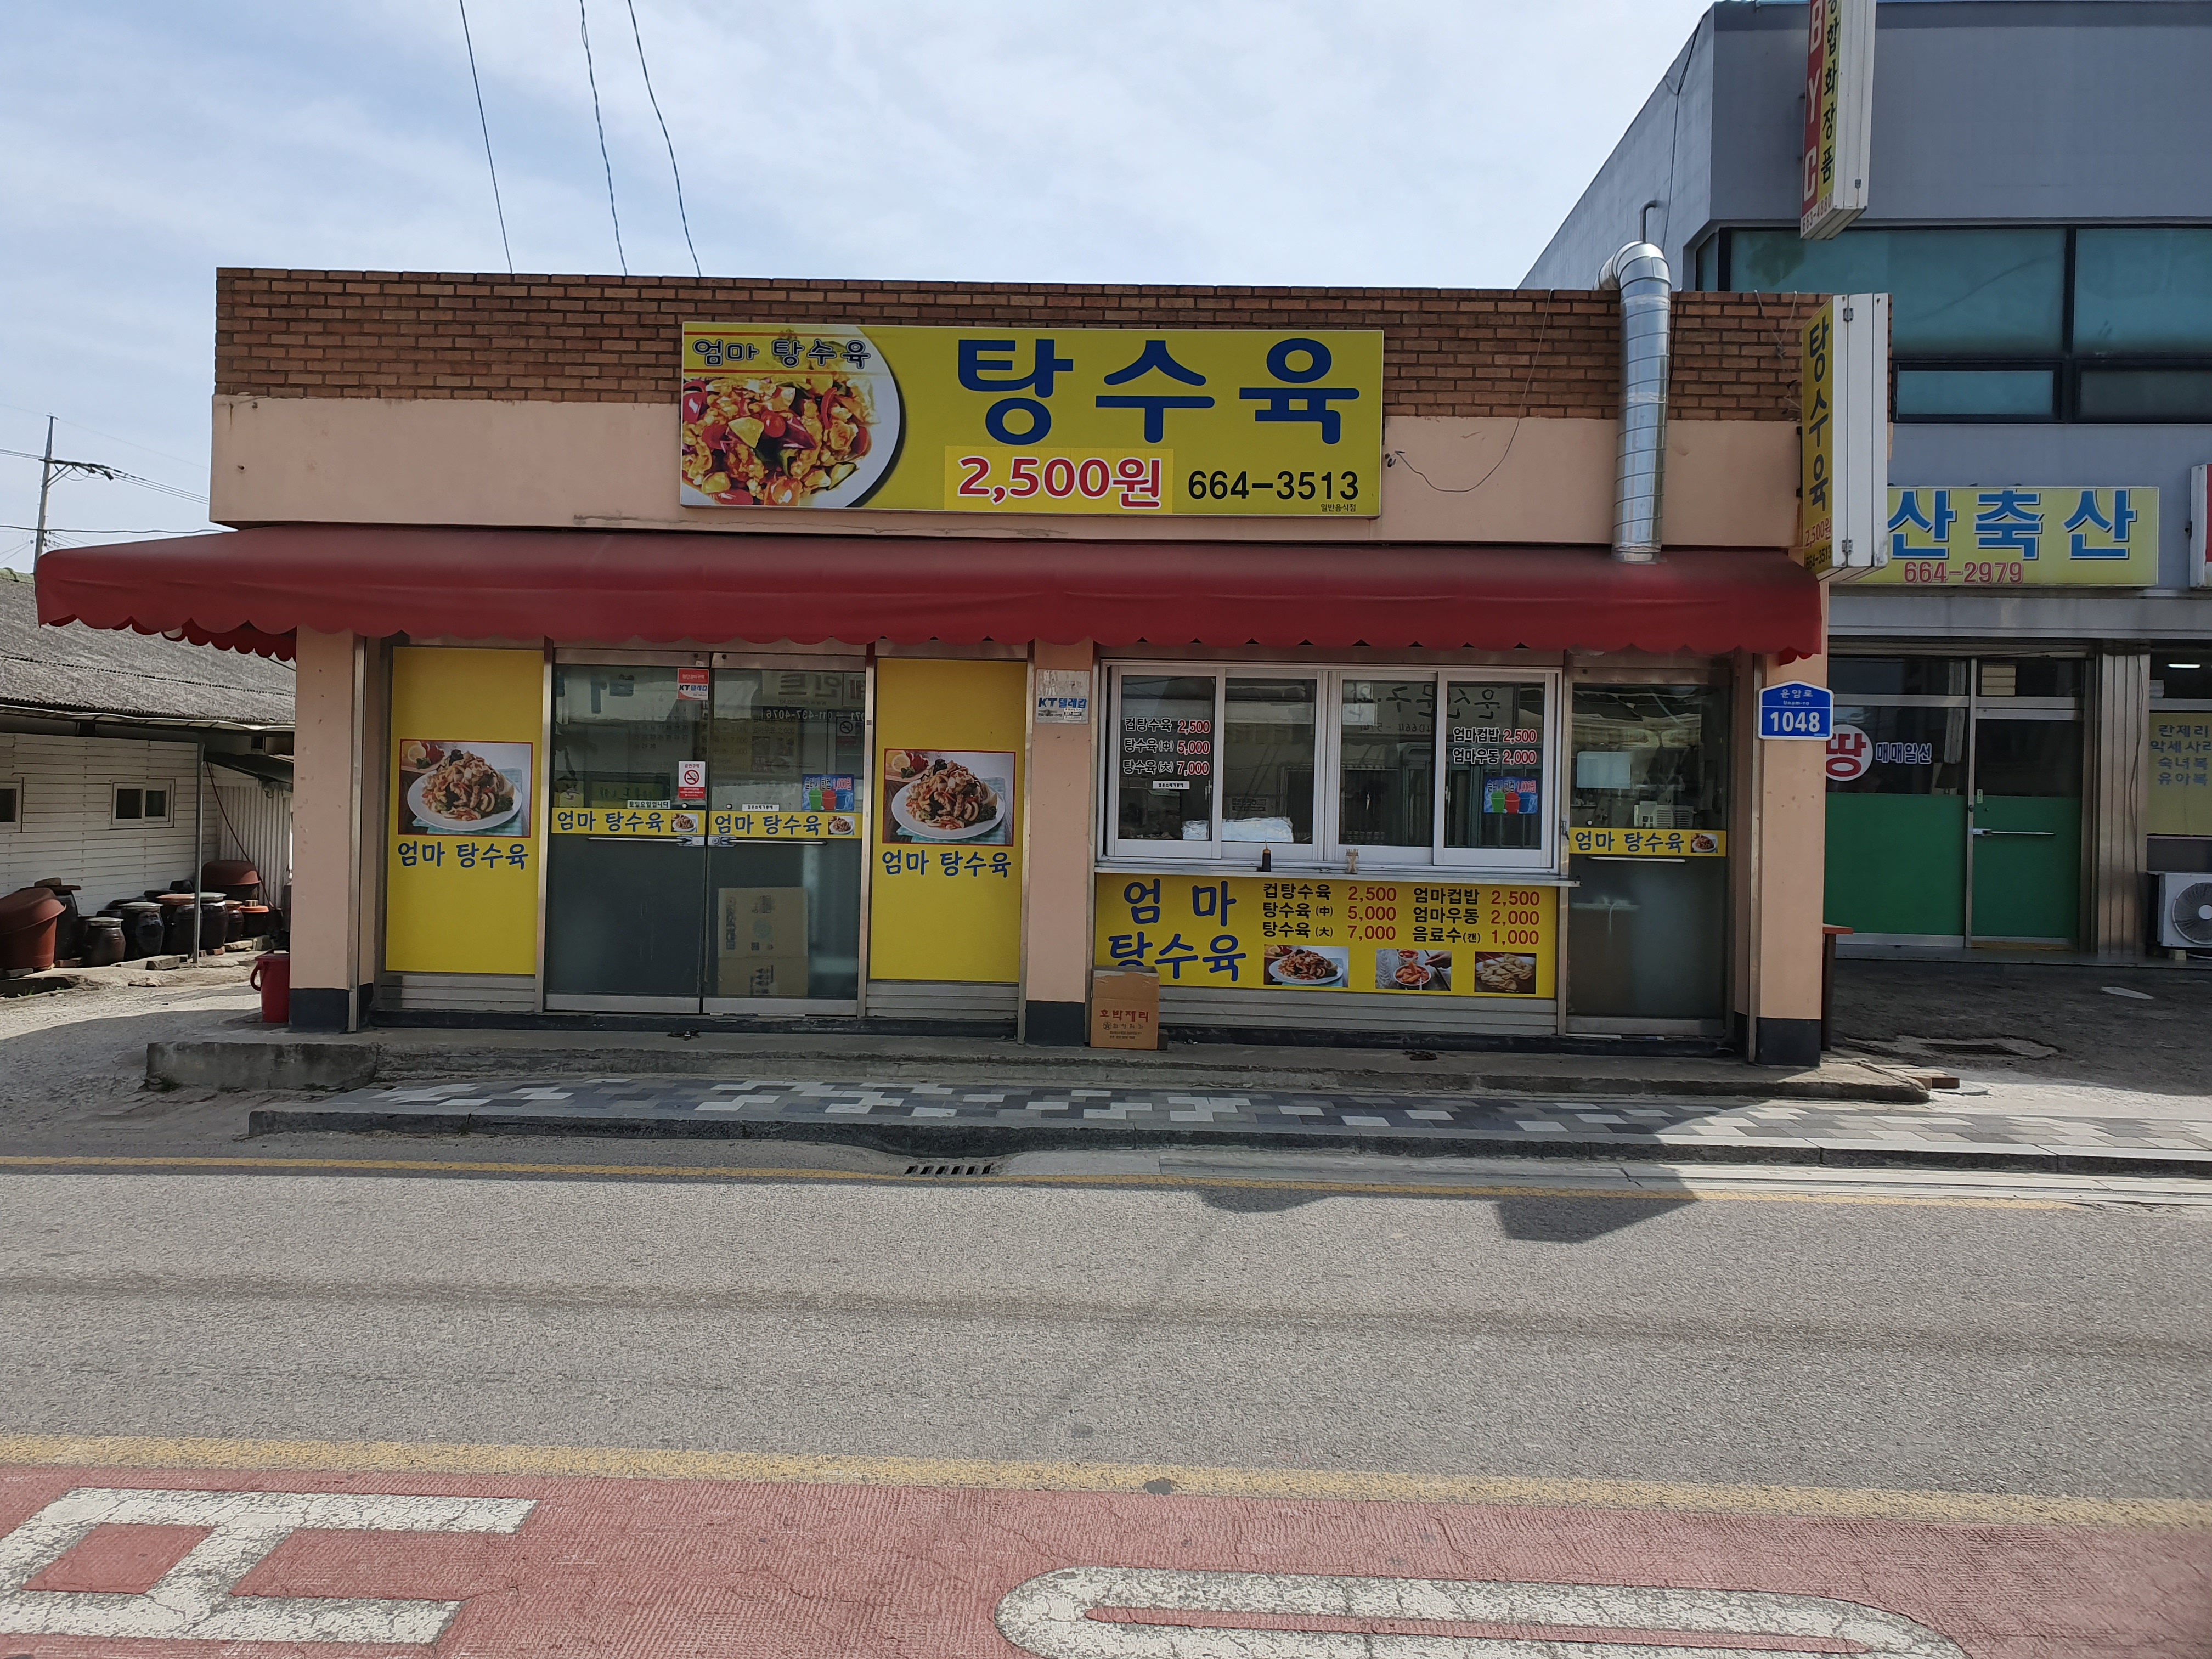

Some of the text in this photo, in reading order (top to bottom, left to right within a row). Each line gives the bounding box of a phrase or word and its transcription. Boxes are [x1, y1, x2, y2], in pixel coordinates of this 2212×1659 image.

[1802, 192, 1832, 233] 663-4880
[692, 337, 872, 370] 엄마 탕수육
[956, 336, 1360, 446] 탕수육
[1809, 315, 1829, 511] 탕수육
[955, 456, 1163, 509] 2,500원
[1188, 470, 1360, 502] 664-3513
[1321, 503, 1356, 512] 일반음식점
[1804, 514, 1832, 549] 2,500원
[1903, 561, 2023, 584] 664-2979
[1780, 689, 1813, 699] 운암로
[1125, 718, 1210, 735] 컵탕수육 2,500
[1770, 711, 1820, 732] 1048
[2158, 725, 2208, 738] 란제리
[1453, 727, 1537, 743] 엄마컵밥 2,500
[1177, 741, 1210, 755] 5,000
[1452, 748, 1537, 765] 엄마우동 2,000
[1875, 742, 1932, 764] 매매알선
[1176, 761, 1210, 776] 7,000
[2158, 757, 2208, 770] 숙녀복
[2158, 772, 2208, 786] 유아복
[557, 810, 664, 833] 엄마 탕수육
[715, 814, 822, 836] 엄마 탕수육
[1575, 831, 1684, 853] 엄마 탕수육
[398, 841, 529, 870] 엄마 탕수육
[882, 850, 1012, 878] 엄마 탕수육
[1262, 882, 1397, 904] 컵탕수육 2,500
[1412, 888, 1540, 908] 엄마컵밥 2,500
[1347, 905, 1397, 923] 5,000
[1412, 906, 1540, 927] 엄마우동 2,000
[1347, 925, 1397, 943] 7,000
[1491, 929, 1539, 946] 1,000
[1108, 932, 1246, 982] 탕수육
